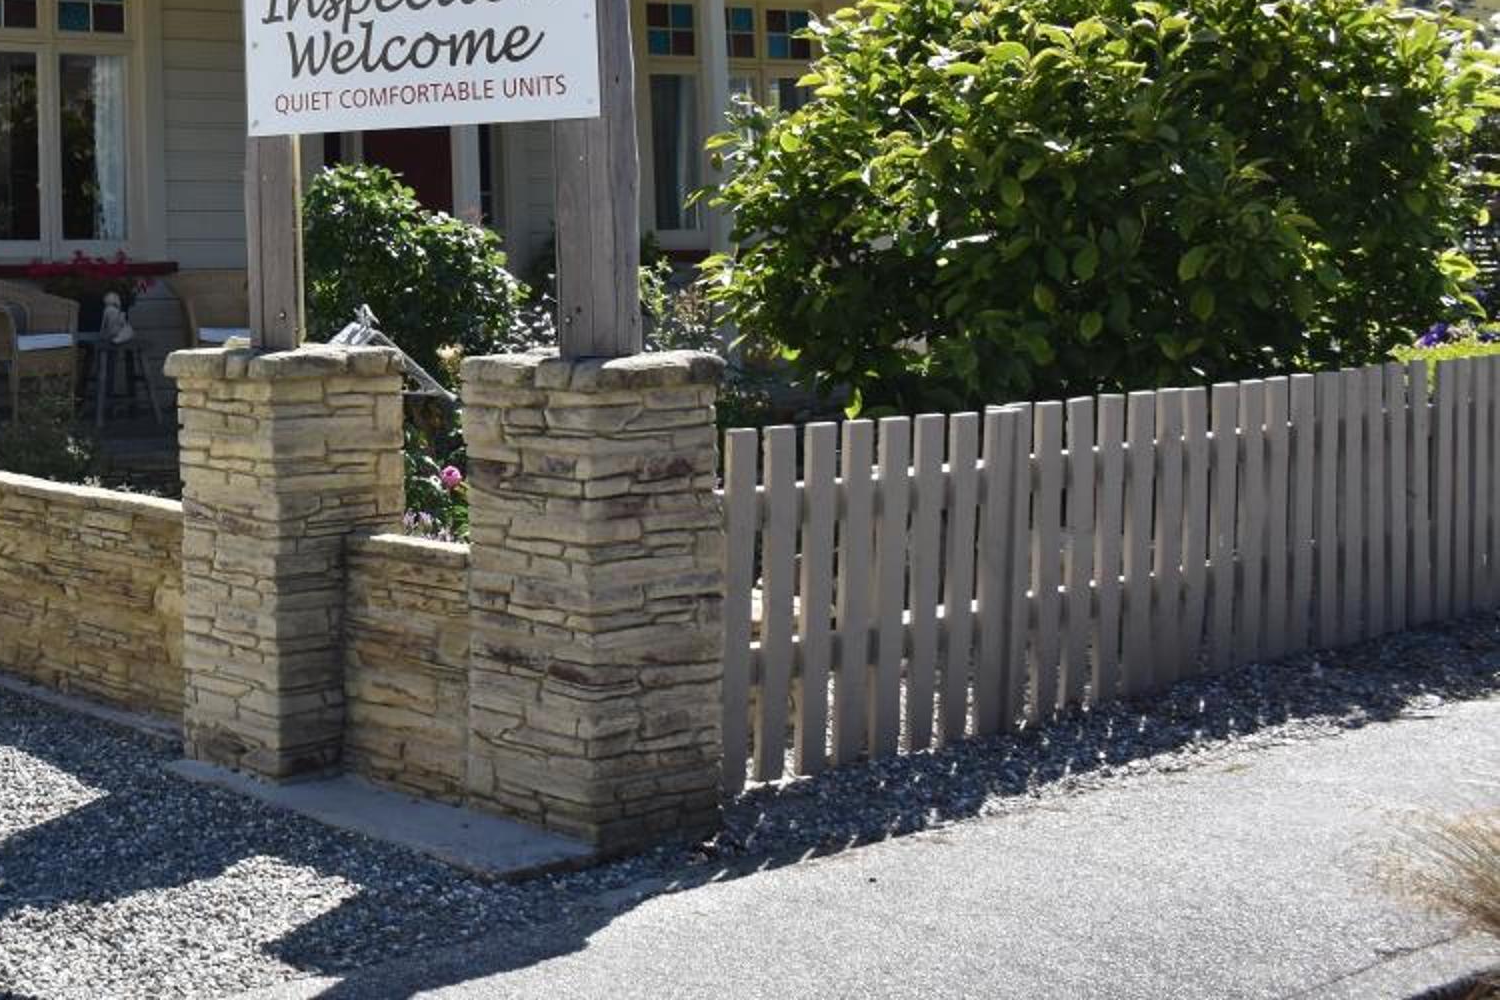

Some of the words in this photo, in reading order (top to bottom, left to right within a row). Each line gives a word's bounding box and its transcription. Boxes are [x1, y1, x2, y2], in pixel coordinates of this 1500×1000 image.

[287, 21, 544, 78] Welcome
[274, 92, 332, 114] QUIET
[338, 79, 494, 109] COMFORTABLE
[502, 75, 567, 98] UNITS
